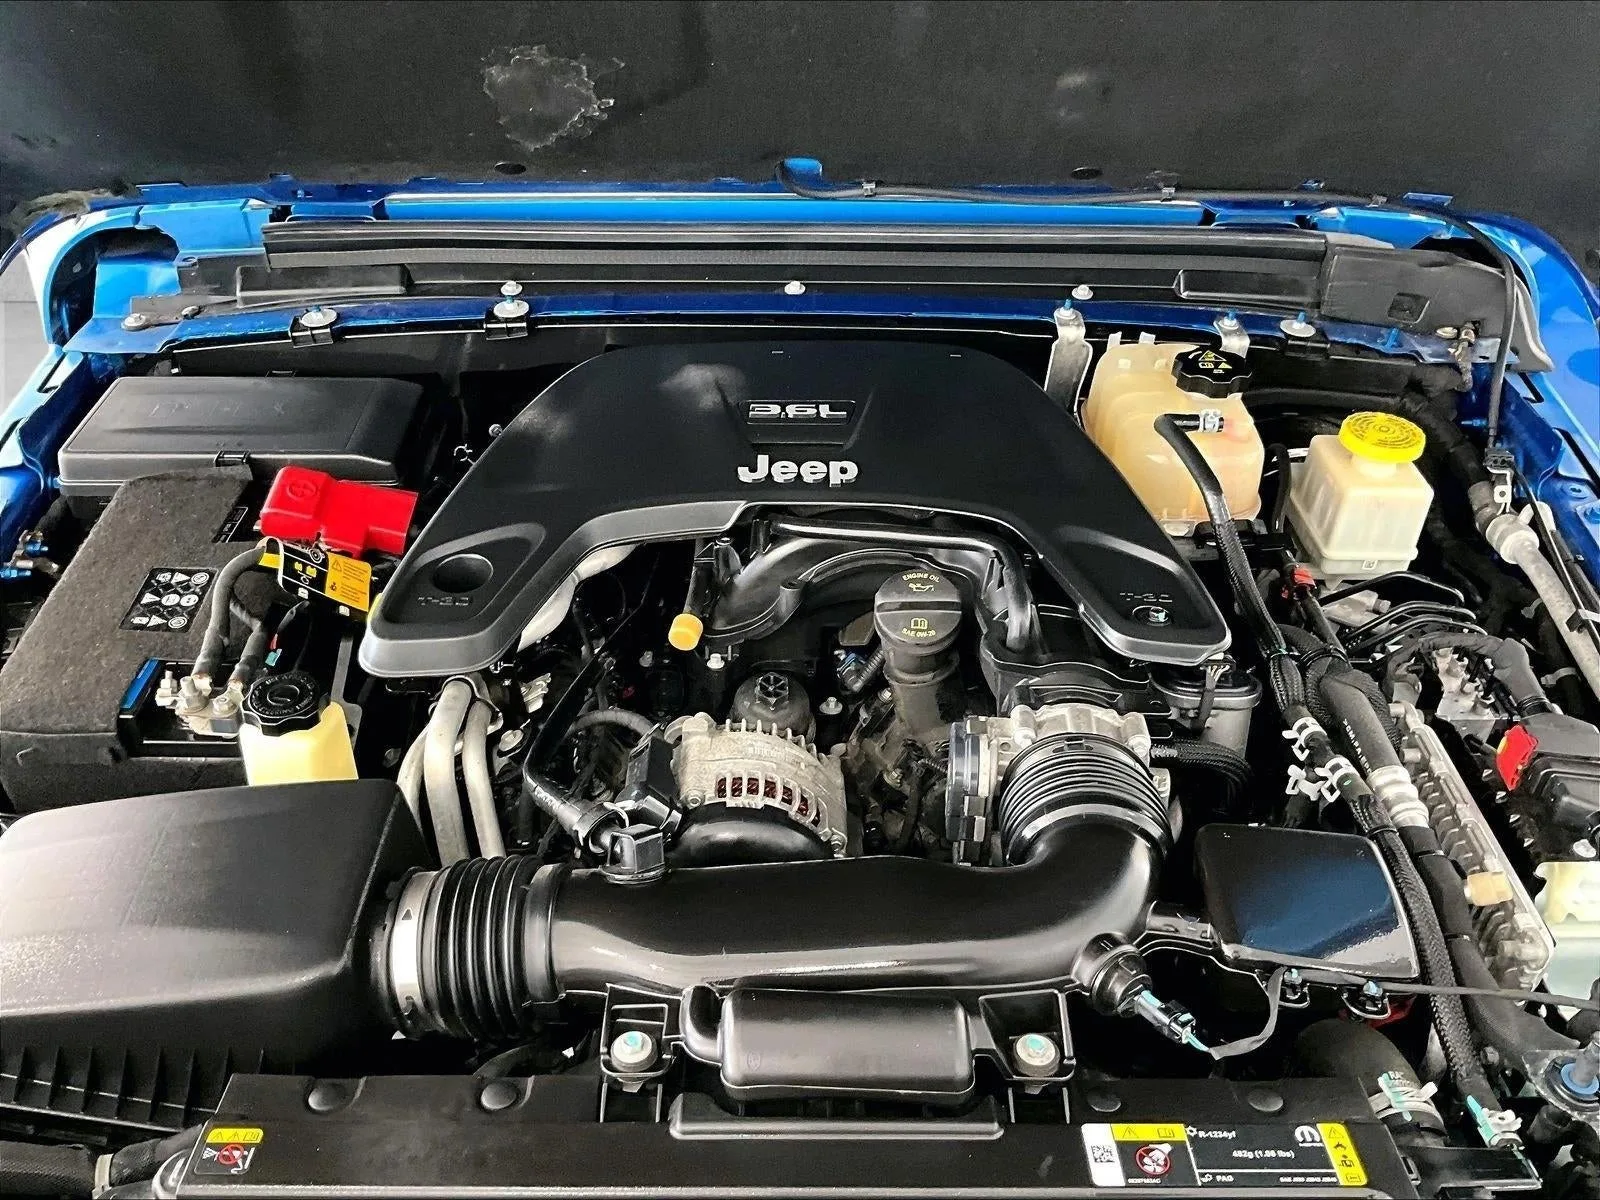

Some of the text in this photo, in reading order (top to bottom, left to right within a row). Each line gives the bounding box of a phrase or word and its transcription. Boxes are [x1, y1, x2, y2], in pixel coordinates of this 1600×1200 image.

[748, 404, 847, 419] 3.6L
[737, 454, 859, 487] Jeep
[902, 572, 940, 582] ENGINE OIL
[902, 627, 936, 638] SAE 0W-20
